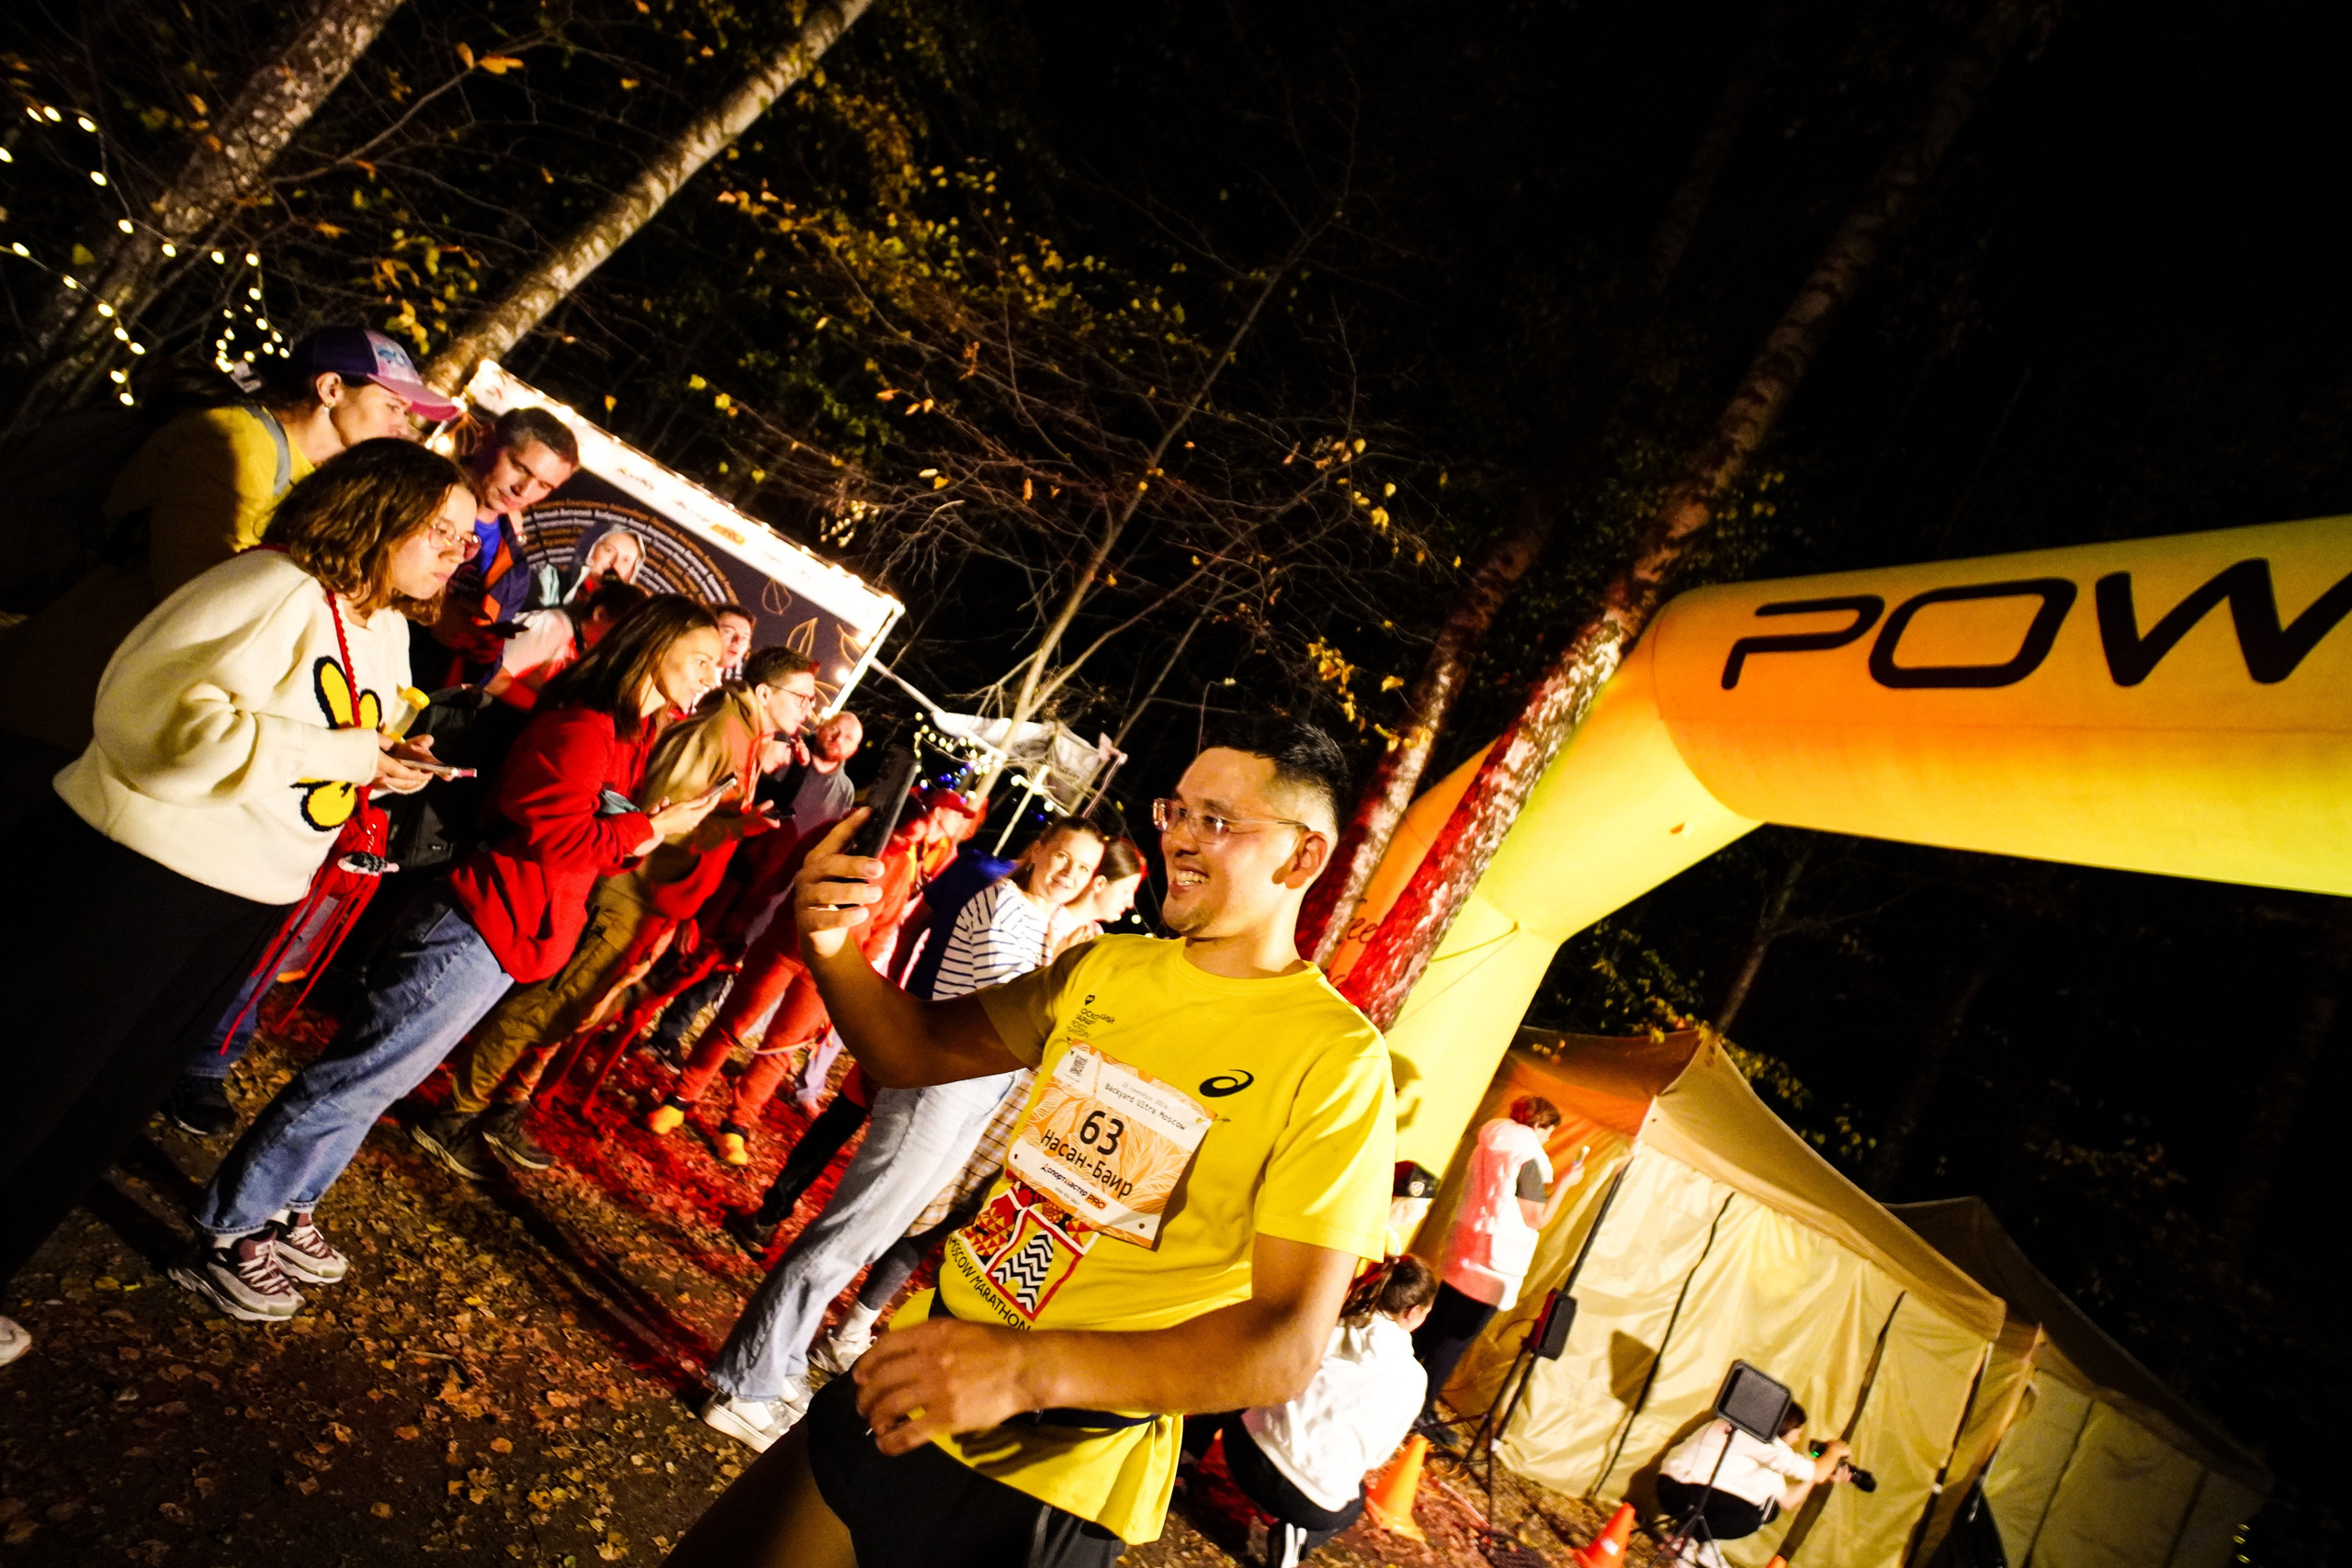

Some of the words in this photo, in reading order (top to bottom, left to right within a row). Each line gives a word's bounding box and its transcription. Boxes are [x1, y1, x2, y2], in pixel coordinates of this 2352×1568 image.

[1720, 557, 2352, 690] POW
[1104, 1082, 1135, 1103] Backyard
[1136, 1099, 1157, 1114] Ultra
[1159, 1111, 1187, 1131] Moscow
[1080, 1110, 1125, 1156] 63
[1040, 1129, 1133, 1199] Насан-Баир
[1087, 1194, 1106, 1210] PRO
[948, 1235, 976, 1278] MOSCOW
